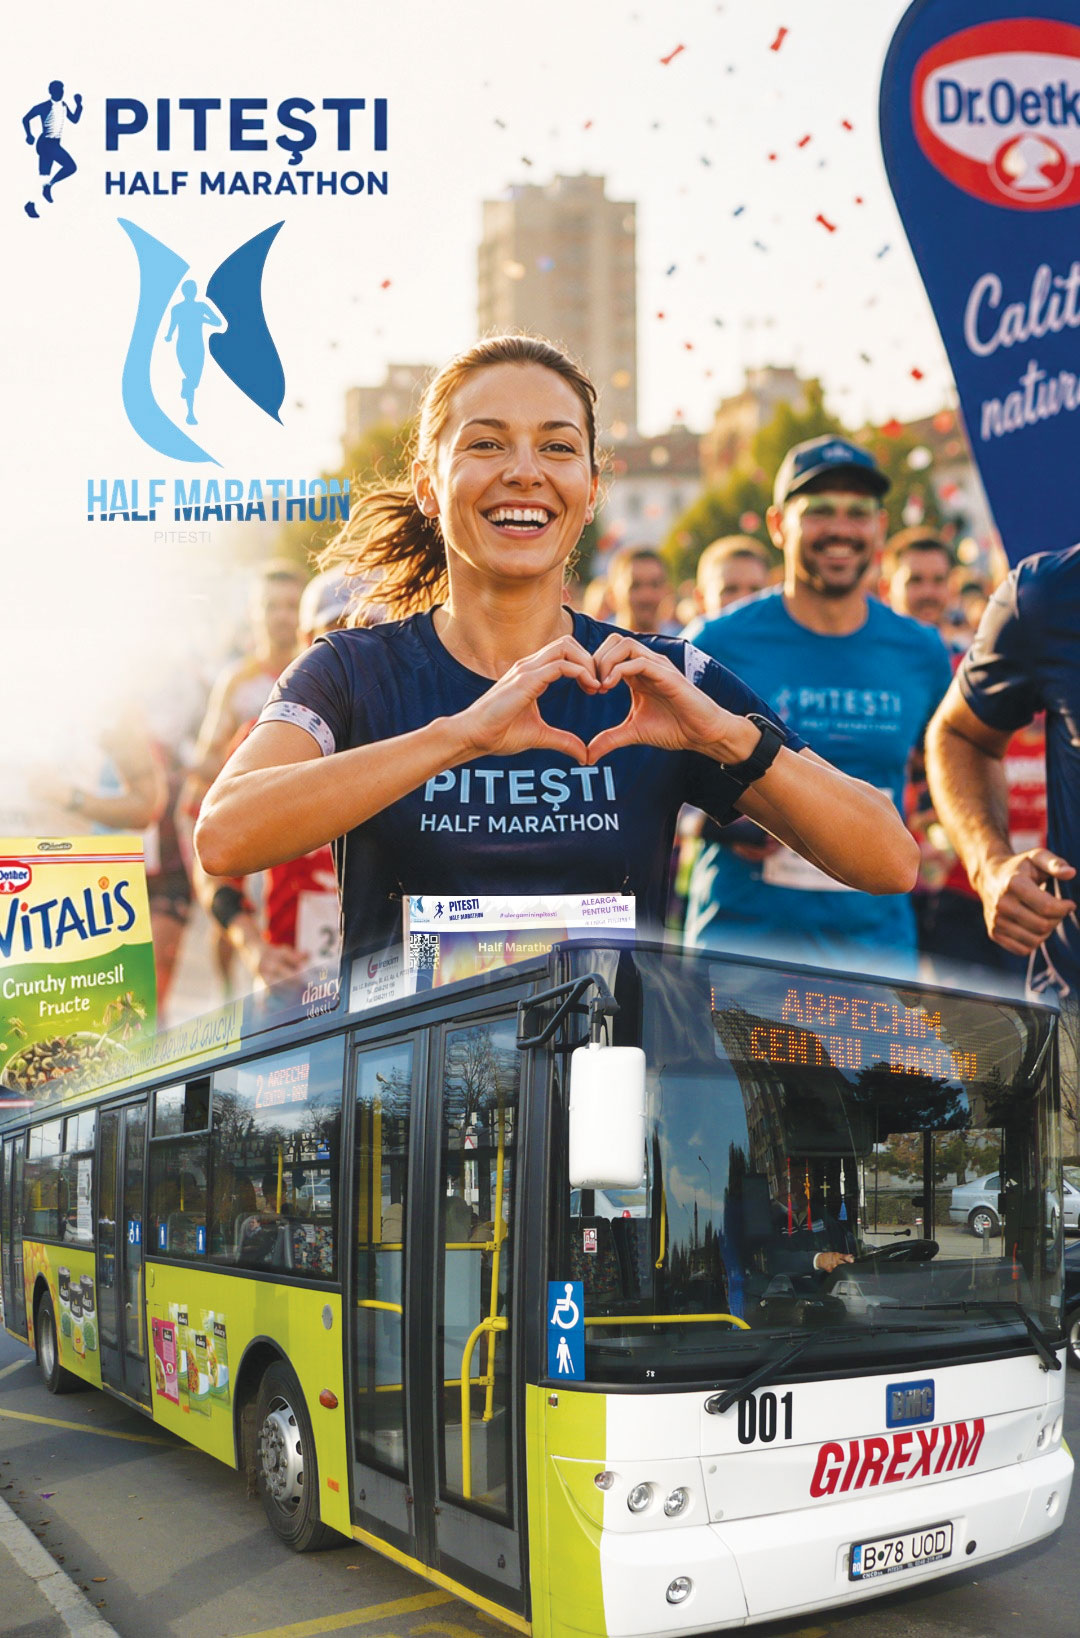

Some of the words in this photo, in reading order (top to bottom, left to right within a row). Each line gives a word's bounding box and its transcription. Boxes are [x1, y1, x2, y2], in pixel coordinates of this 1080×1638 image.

[981, 359, 1080, 441] natur
[420, 814, 480, 832] HALF
[488, 813, 620, 833] MARATHON
[449, 899, 479, 912] PITESTI
[581, 897, 617, 906] ALEARGA
[582, 907, 611, 916] PENTRU
[478, 942, 503, 952] Half
[505, 942, 560, 952] Marathon
[39, 996, 91, 1017] Fructe
[781, 988, 942, 1040] ARPECHIM
[750, 1026, 862, 1070] CENTRU
[889, 1043, 977, 1081] BASCOV
[738, 1391, 793, 1445] 001
[892, 1387, 932, 1420] BMC
[809, 1418, 985, 1498] GIREXIM
[853, 1562, 861, 1573] RO
[912, 1531, 946, 1559] UOD
